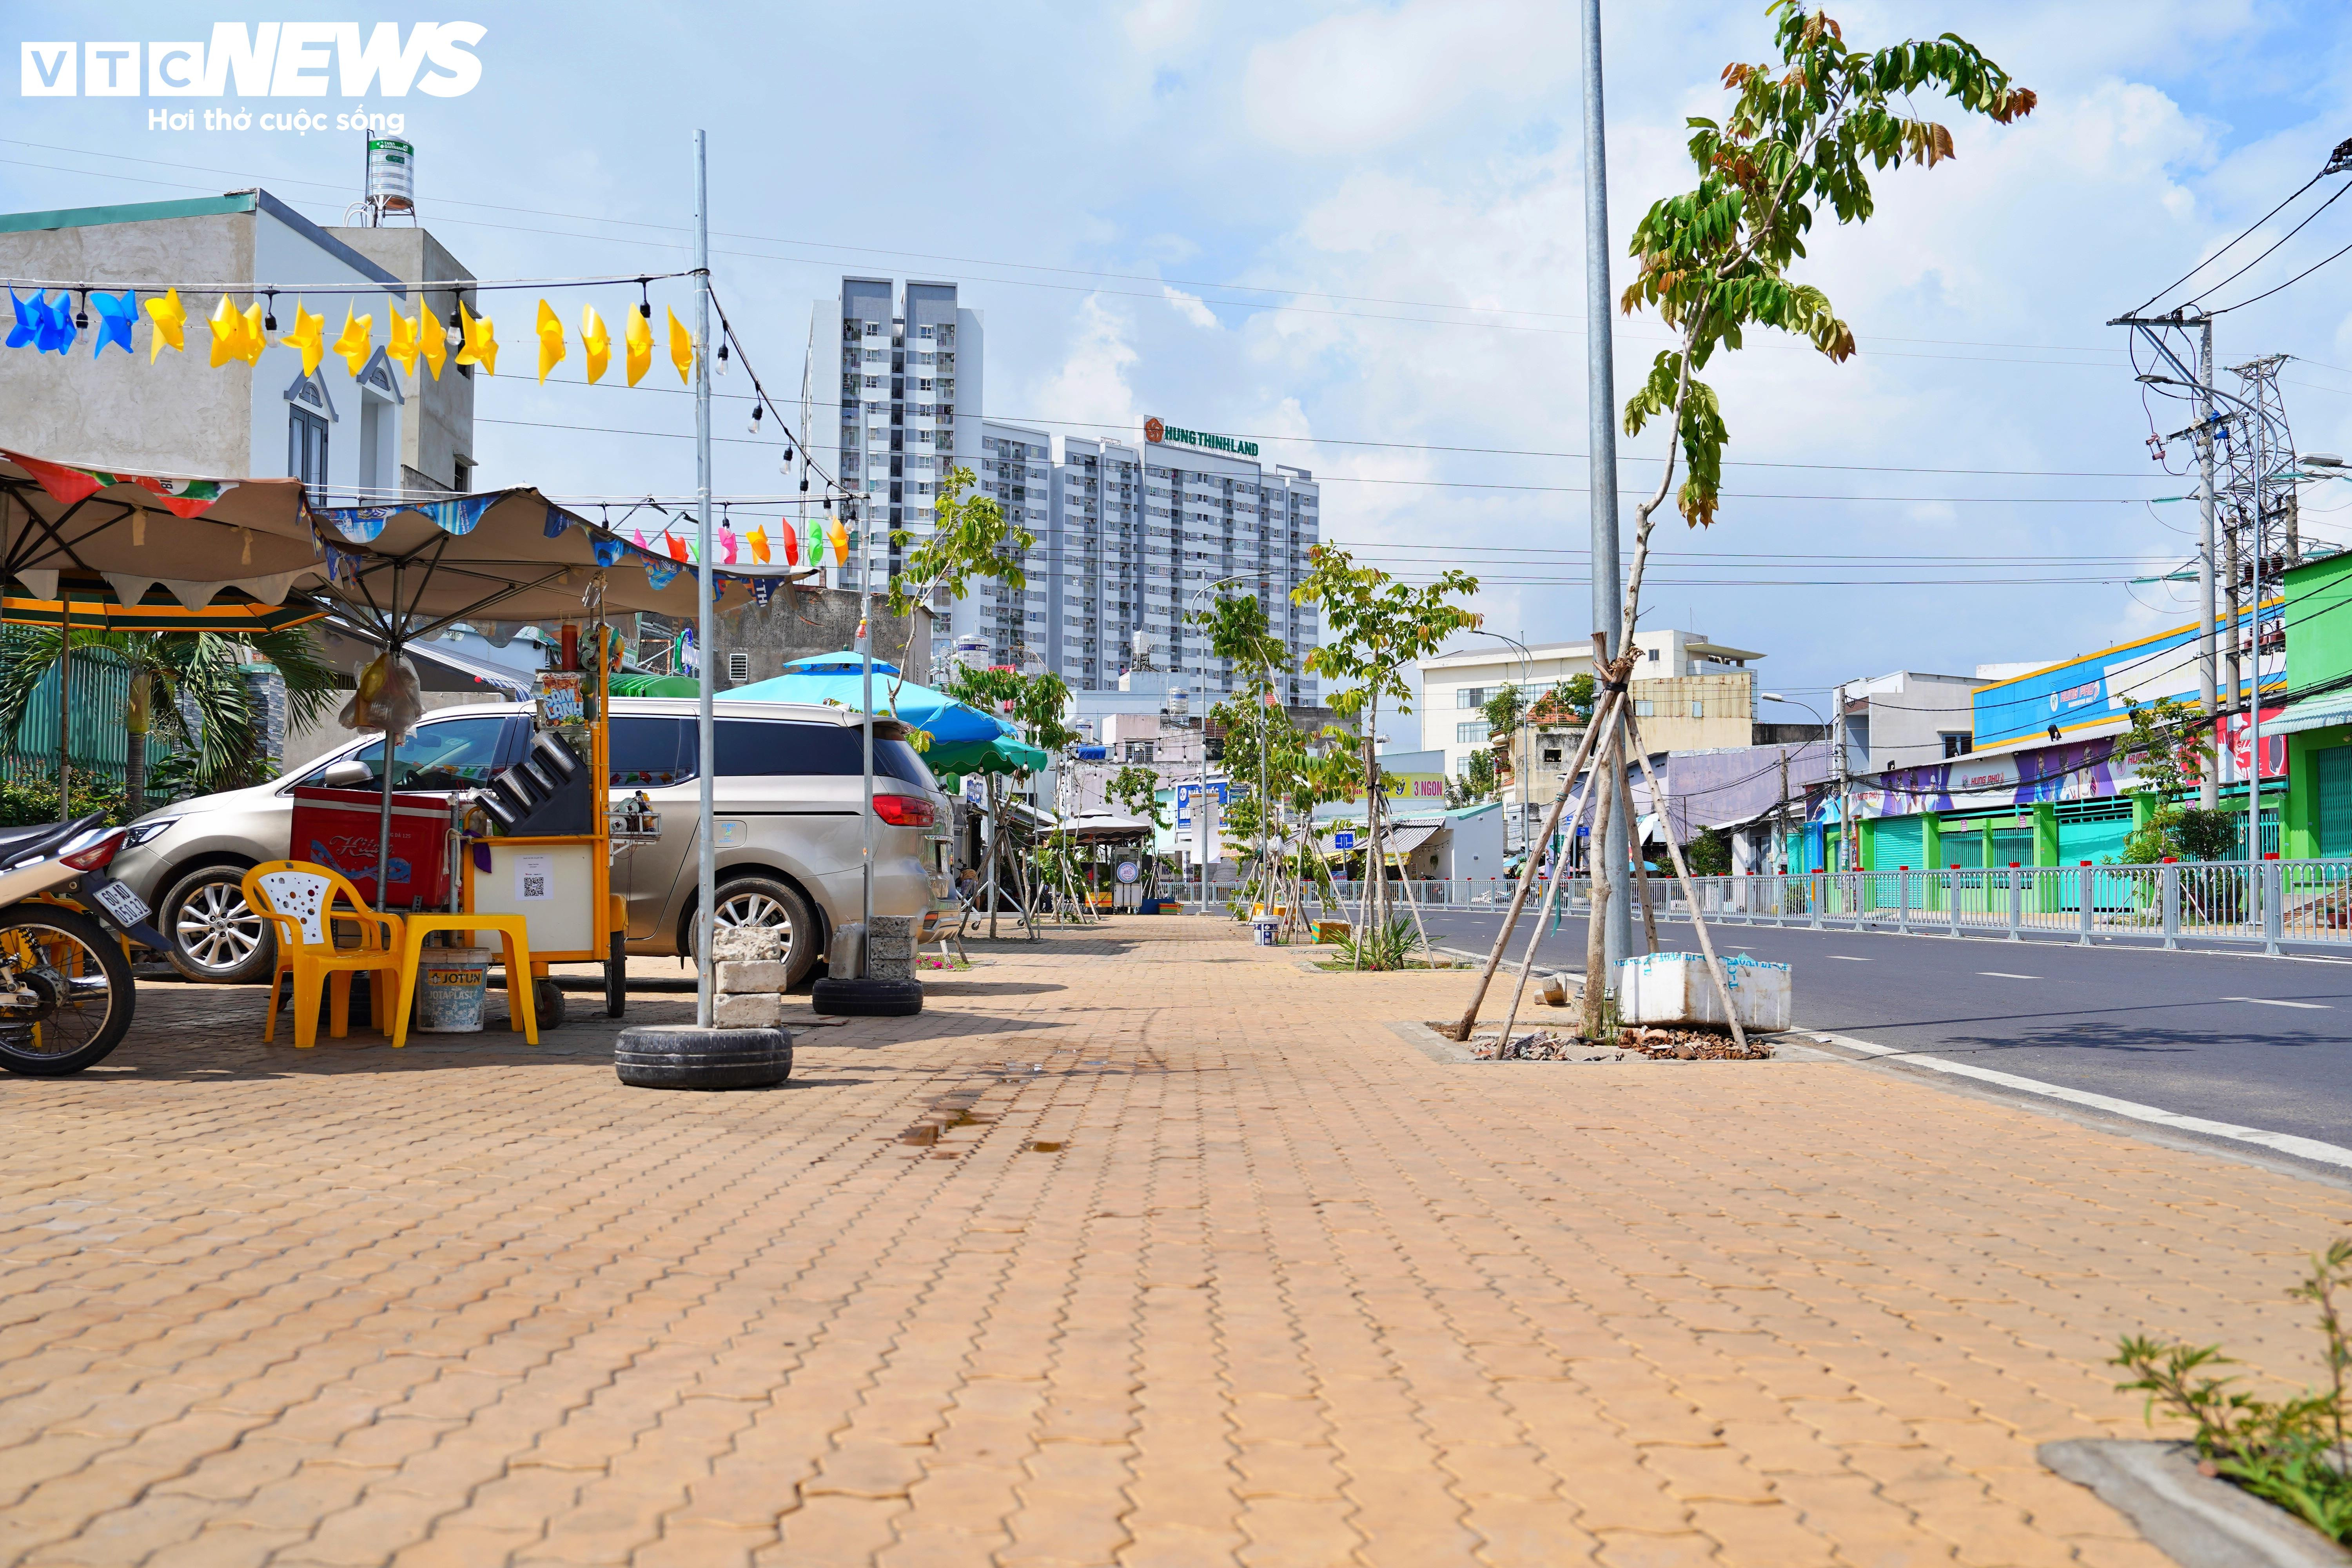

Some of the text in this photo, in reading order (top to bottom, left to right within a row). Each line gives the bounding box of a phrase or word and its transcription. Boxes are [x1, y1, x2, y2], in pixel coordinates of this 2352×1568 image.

[1231, 439, 1258, 456] LAND
[544, 688, 575, 707] SÂM
[1414, 780, 1443, 796] 3 NGON
[114, 898, 148, 923] 050.32
[442, 973, 480, 984] JOTUN
